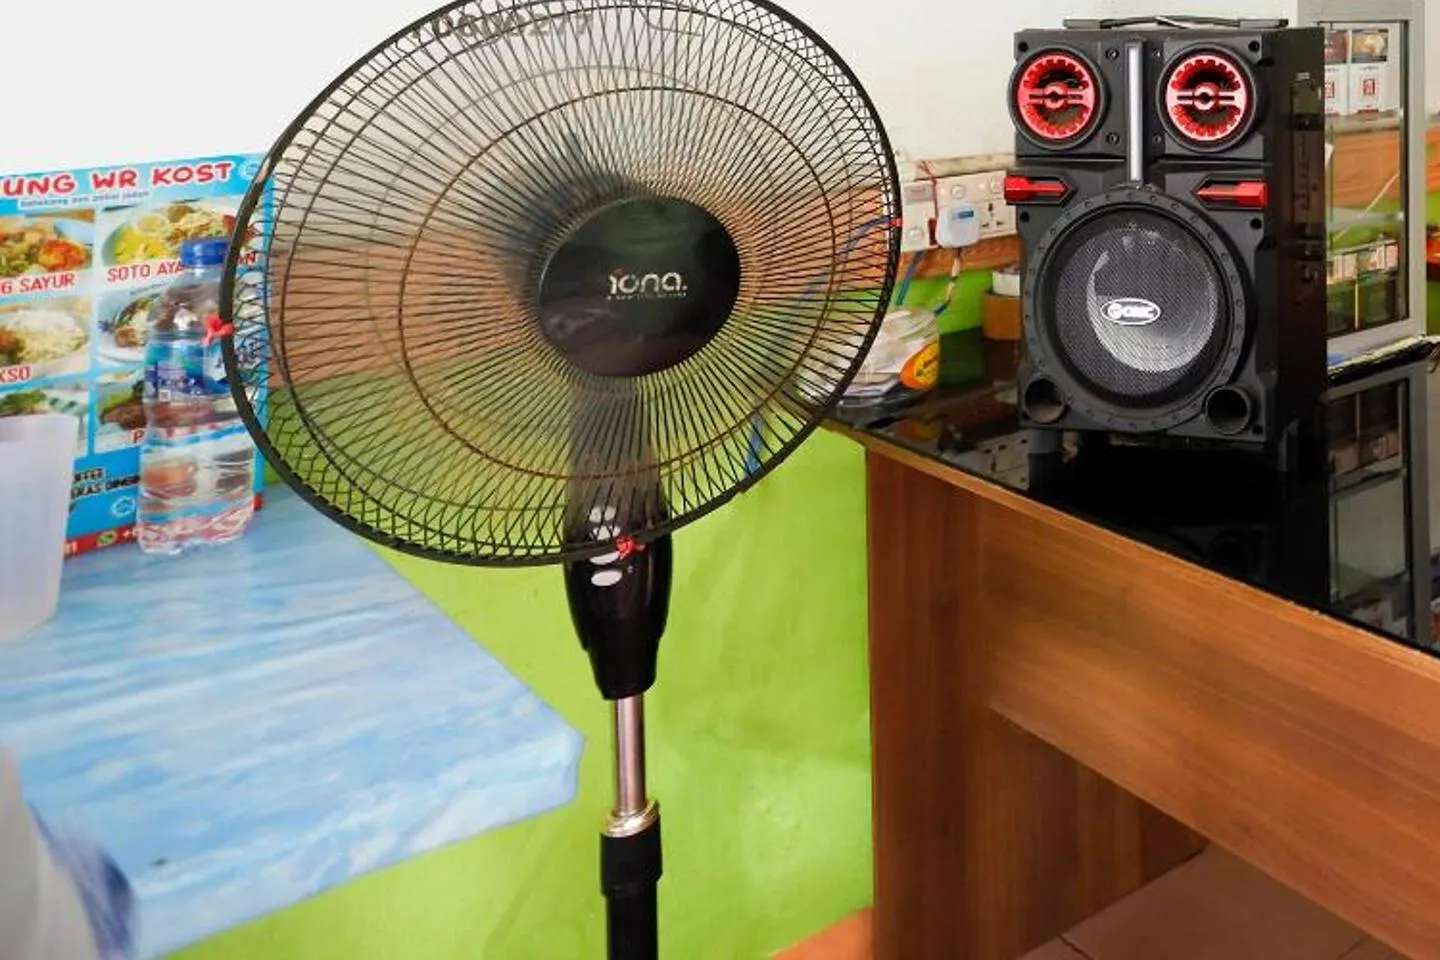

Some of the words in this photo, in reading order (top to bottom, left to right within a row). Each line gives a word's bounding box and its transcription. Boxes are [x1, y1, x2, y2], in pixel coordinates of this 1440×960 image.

[92, 168, 137, 189] WR
[152, 162, 232, 185] KOST
[20, 272, 76, 292] SAYUR
[107, 264, 151, 283] SOTO
[157, 258, 186, 276] AYA
